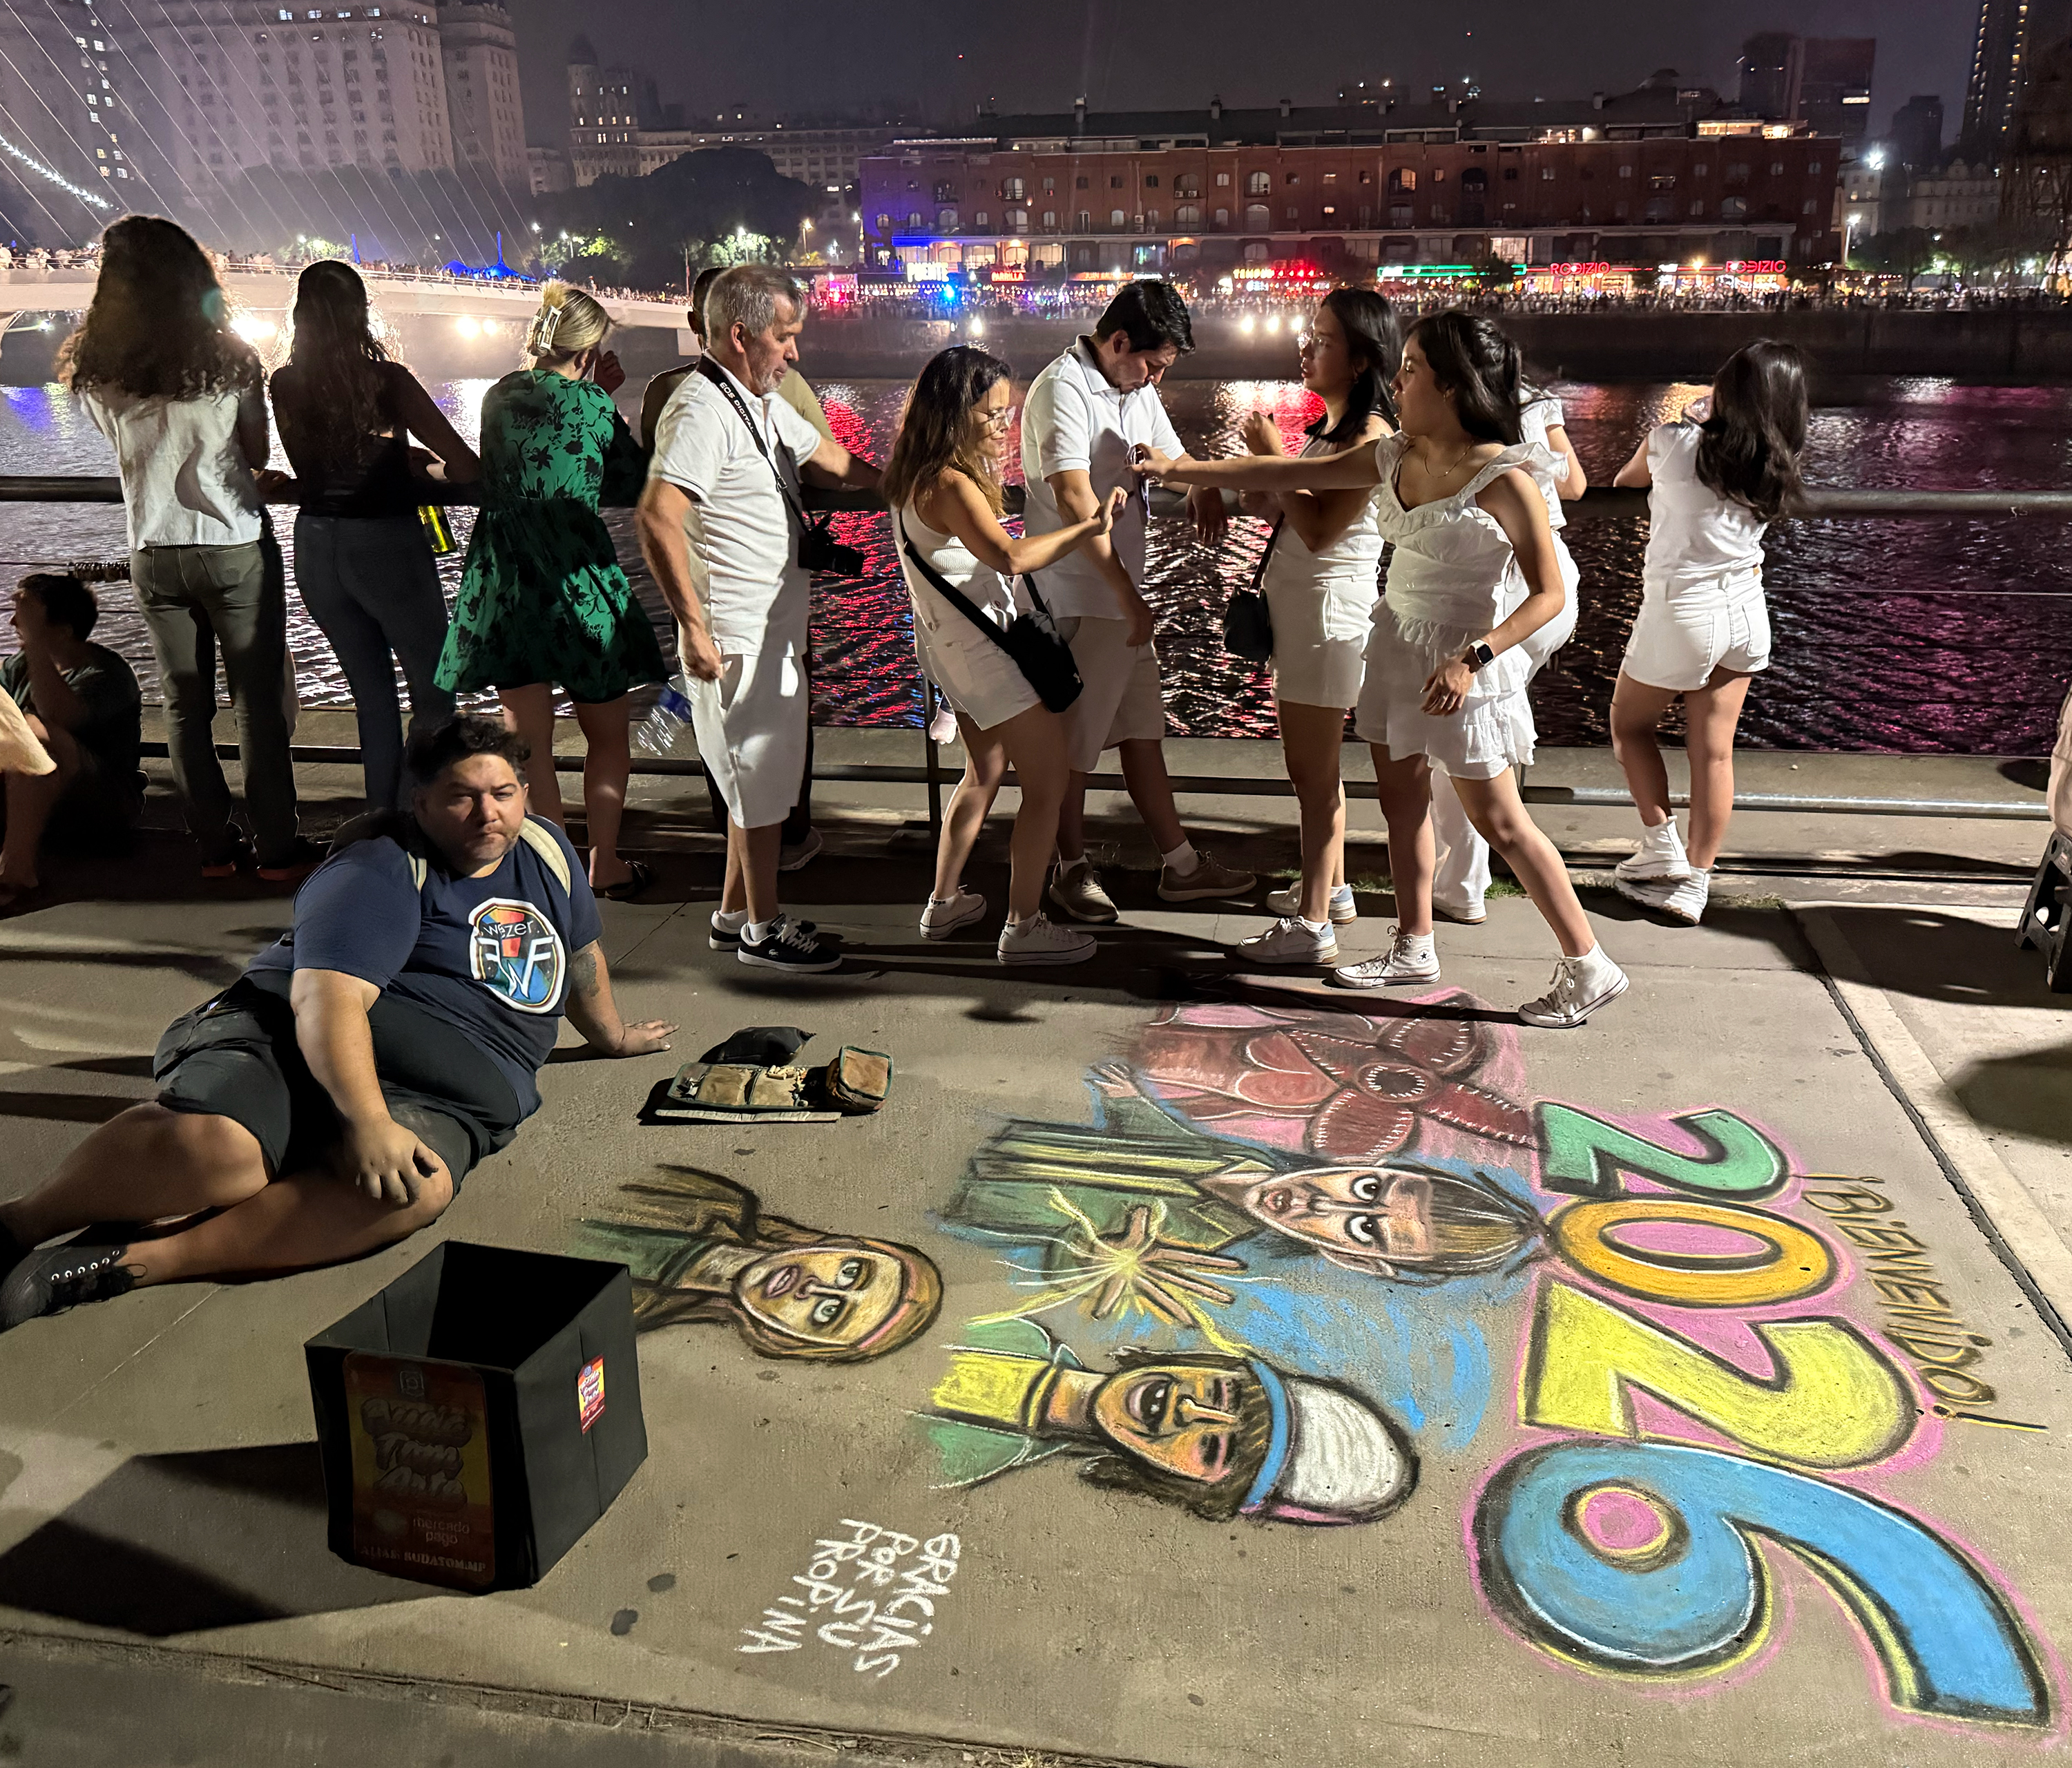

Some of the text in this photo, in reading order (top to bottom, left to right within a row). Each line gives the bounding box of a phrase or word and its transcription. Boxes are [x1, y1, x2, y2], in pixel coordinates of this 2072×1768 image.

[907, 262, 950, 282] PUENTE
[991, 271, 1024, 282] PARRILLA
[1550, 262, 1611, 276] RODIZIO
[719, 382, 754, 432] EOS DIGITAL
[1470, 1099, 2051, 1729] 2026
[413, 1517, 470, 1535] mercado
[425, 1532, 459, 1547] pago
[734, 1518, 884, 1653] PROPINA
[817, 1530, 919, 1649] POR SU
[854, 1532, 961, 1678] GRACIAS
